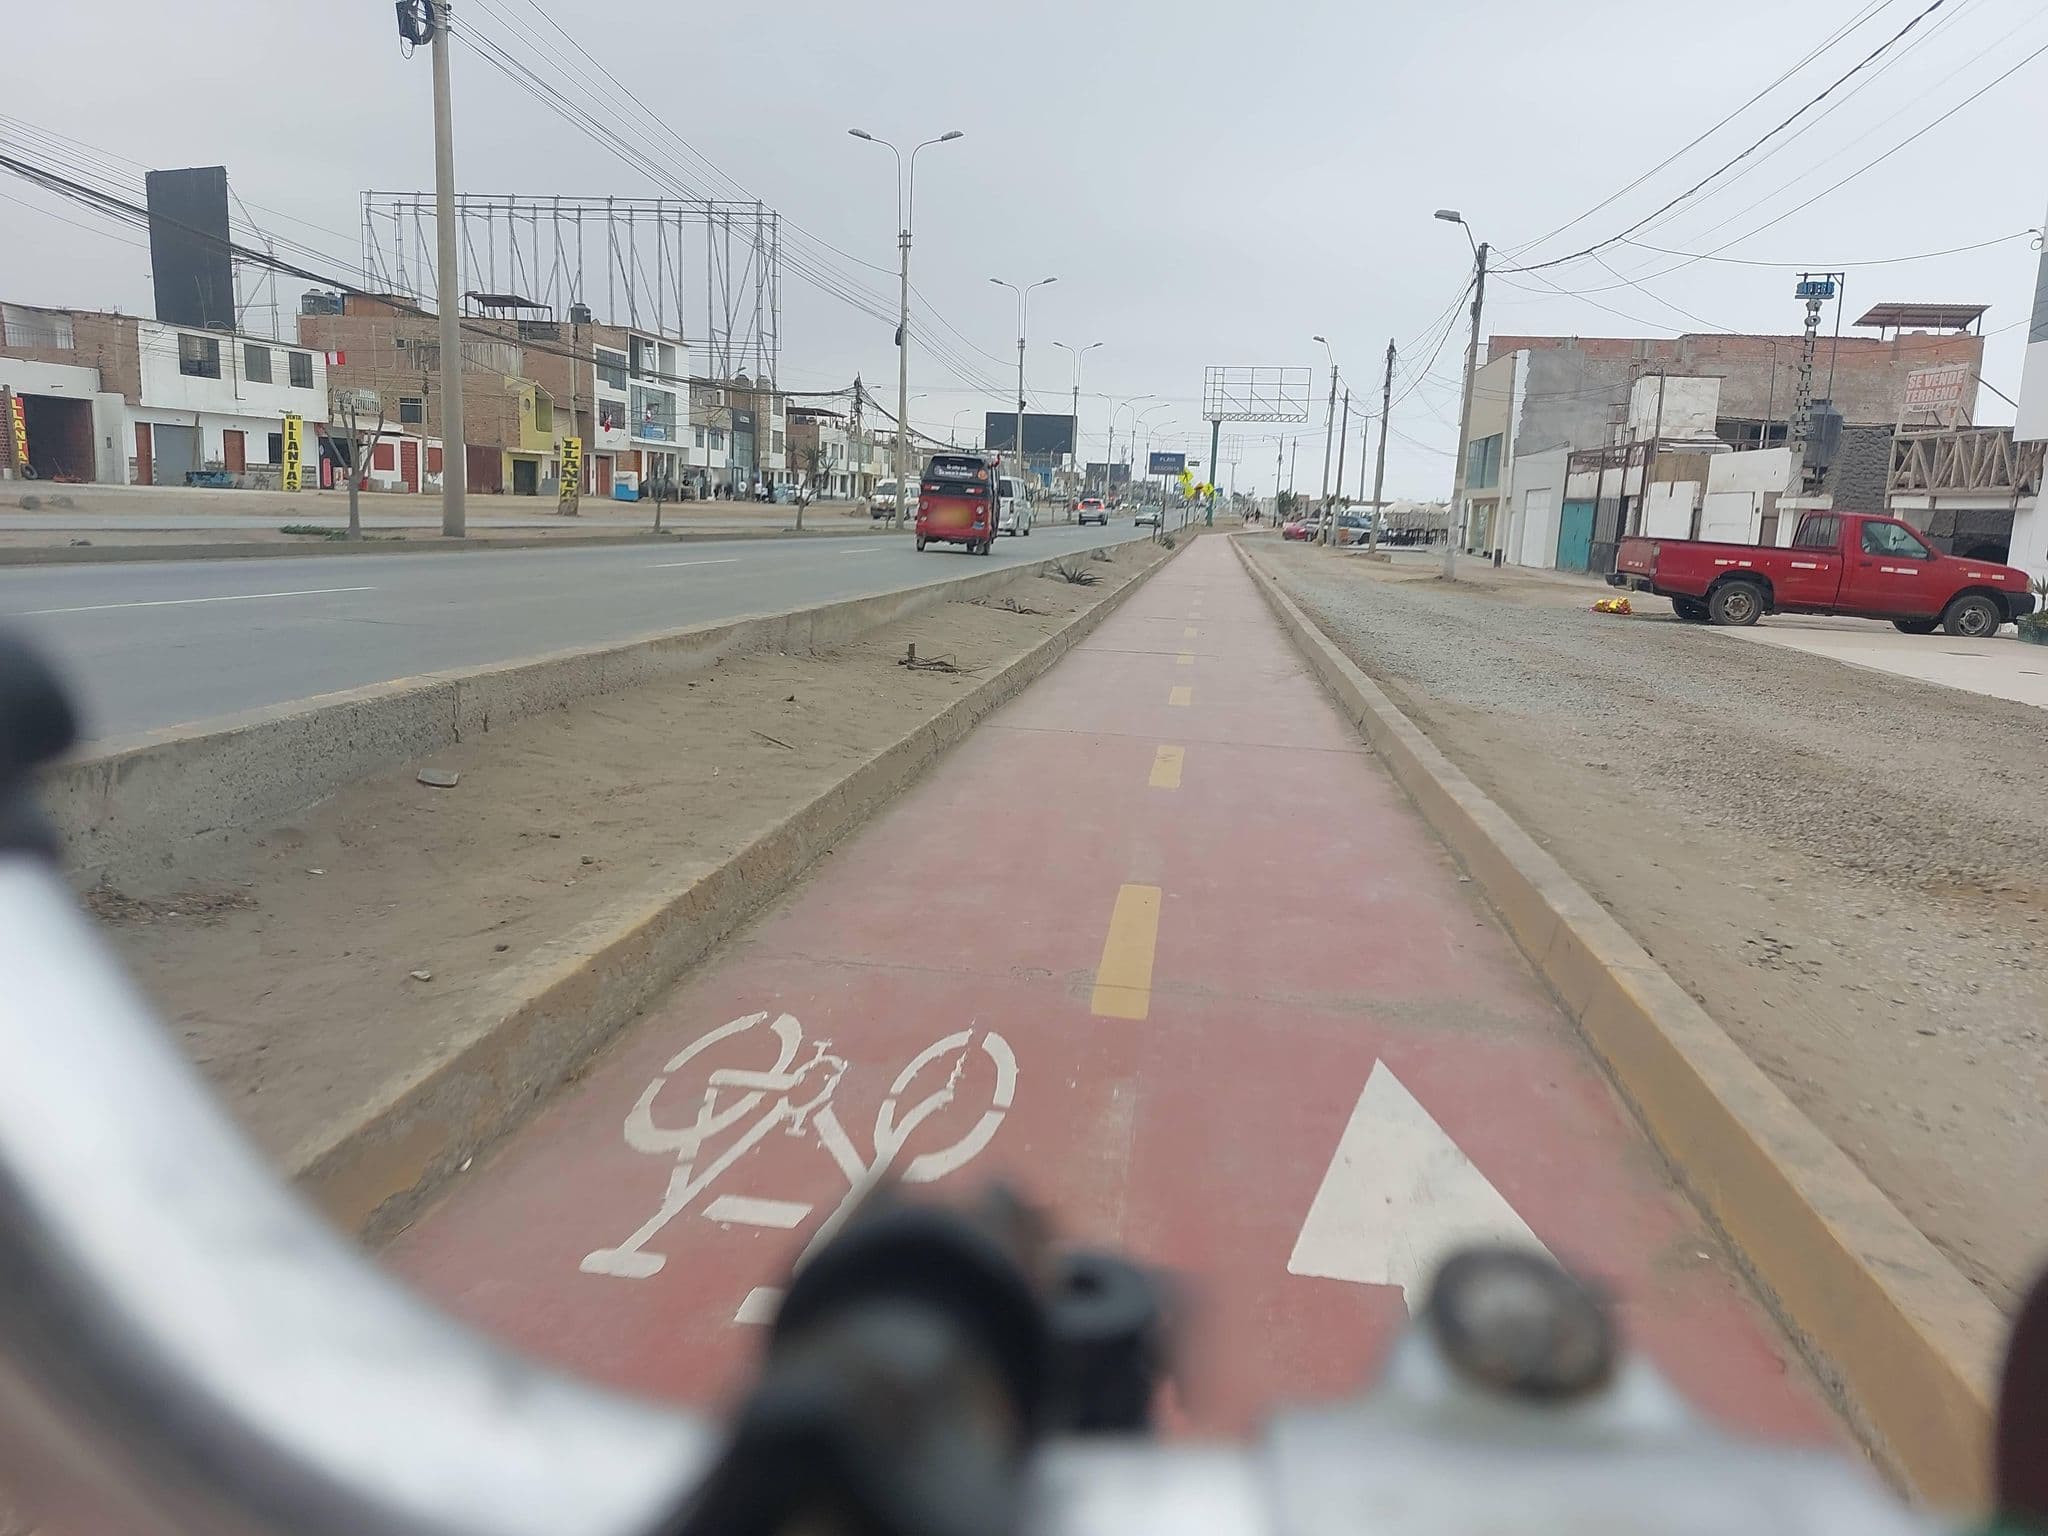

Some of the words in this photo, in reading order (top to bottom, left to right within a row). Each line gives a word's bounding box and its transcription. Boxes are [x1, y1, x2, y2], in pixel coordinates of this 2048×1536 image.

[1905, 385, 1960, 404] TERRENO
[1907, 375, 1923, 389] SE
[1924, 369, 1966, 388] VENDE
[11, 398, 30, 464] LLANTA
[286, 421, 299, 492] LLANTAS
